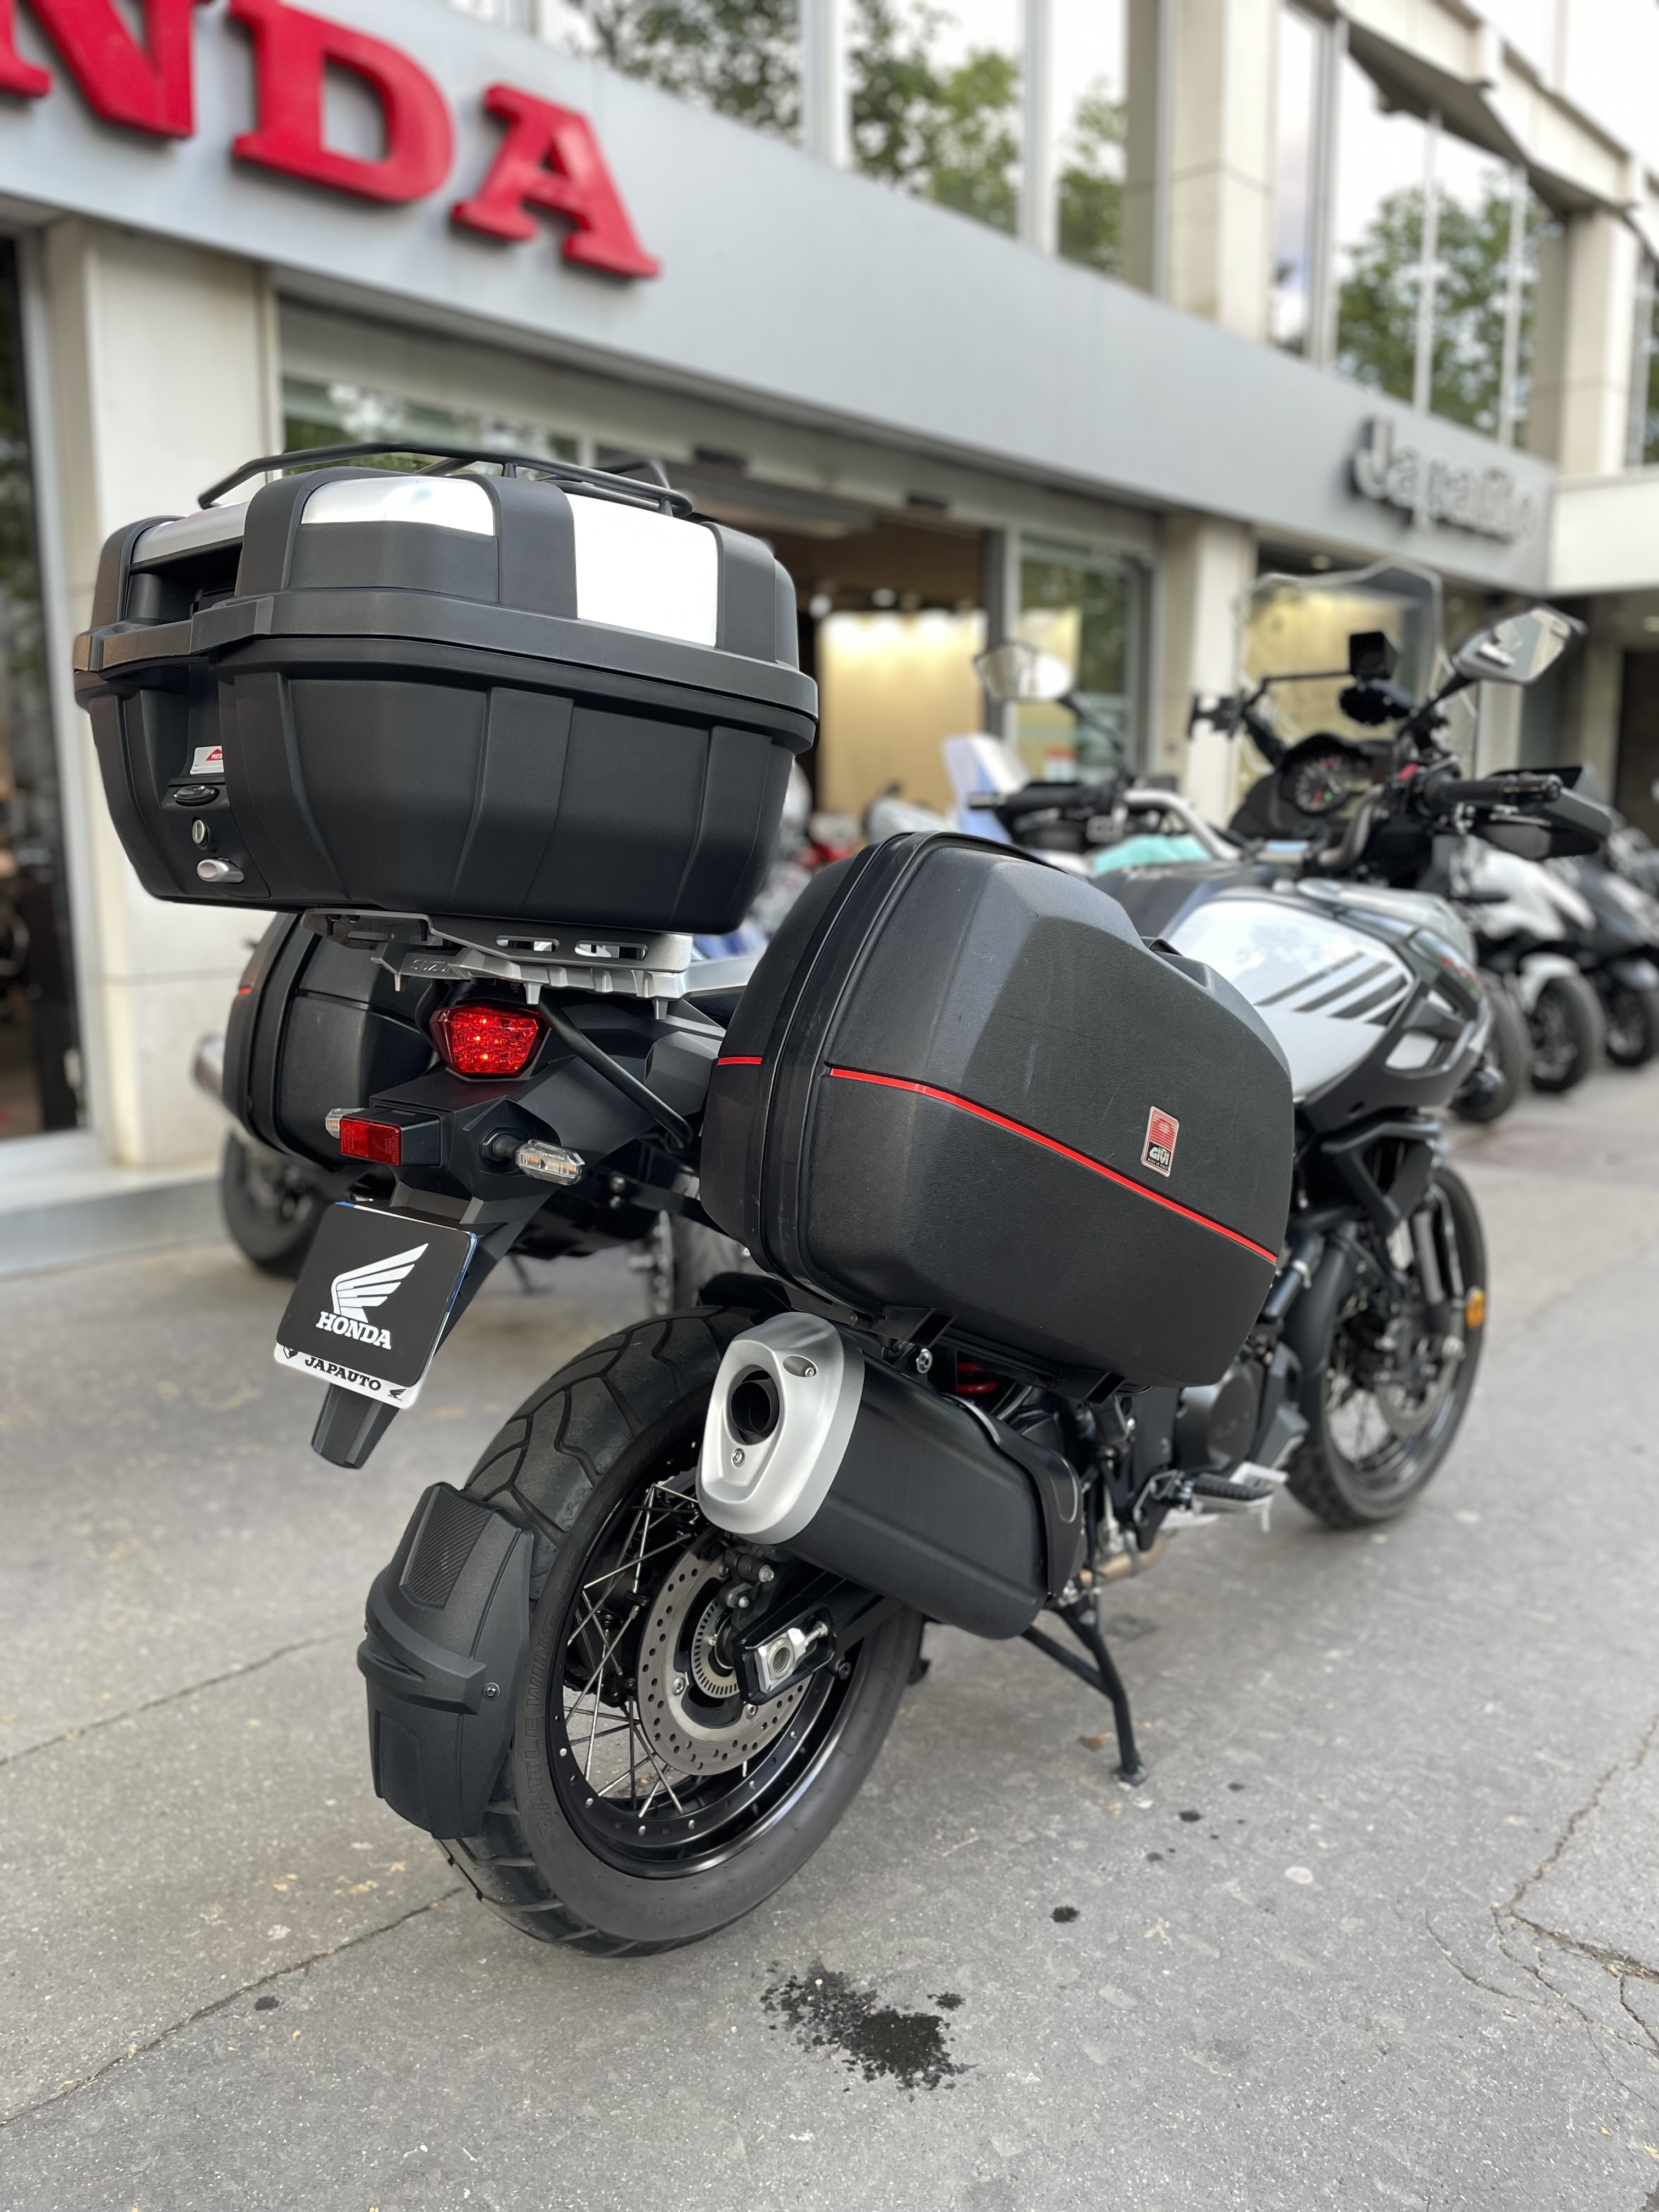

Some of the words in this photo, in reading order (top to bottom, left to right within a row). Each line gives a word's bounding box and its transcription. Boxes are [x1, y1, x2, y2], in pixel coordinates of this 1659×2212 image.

[1149, 1147, 1170, 1166] GIVI
[315, 1311, 392, 1350] HONDA
[304, 1356, 381, 1392] JAPAUTO
